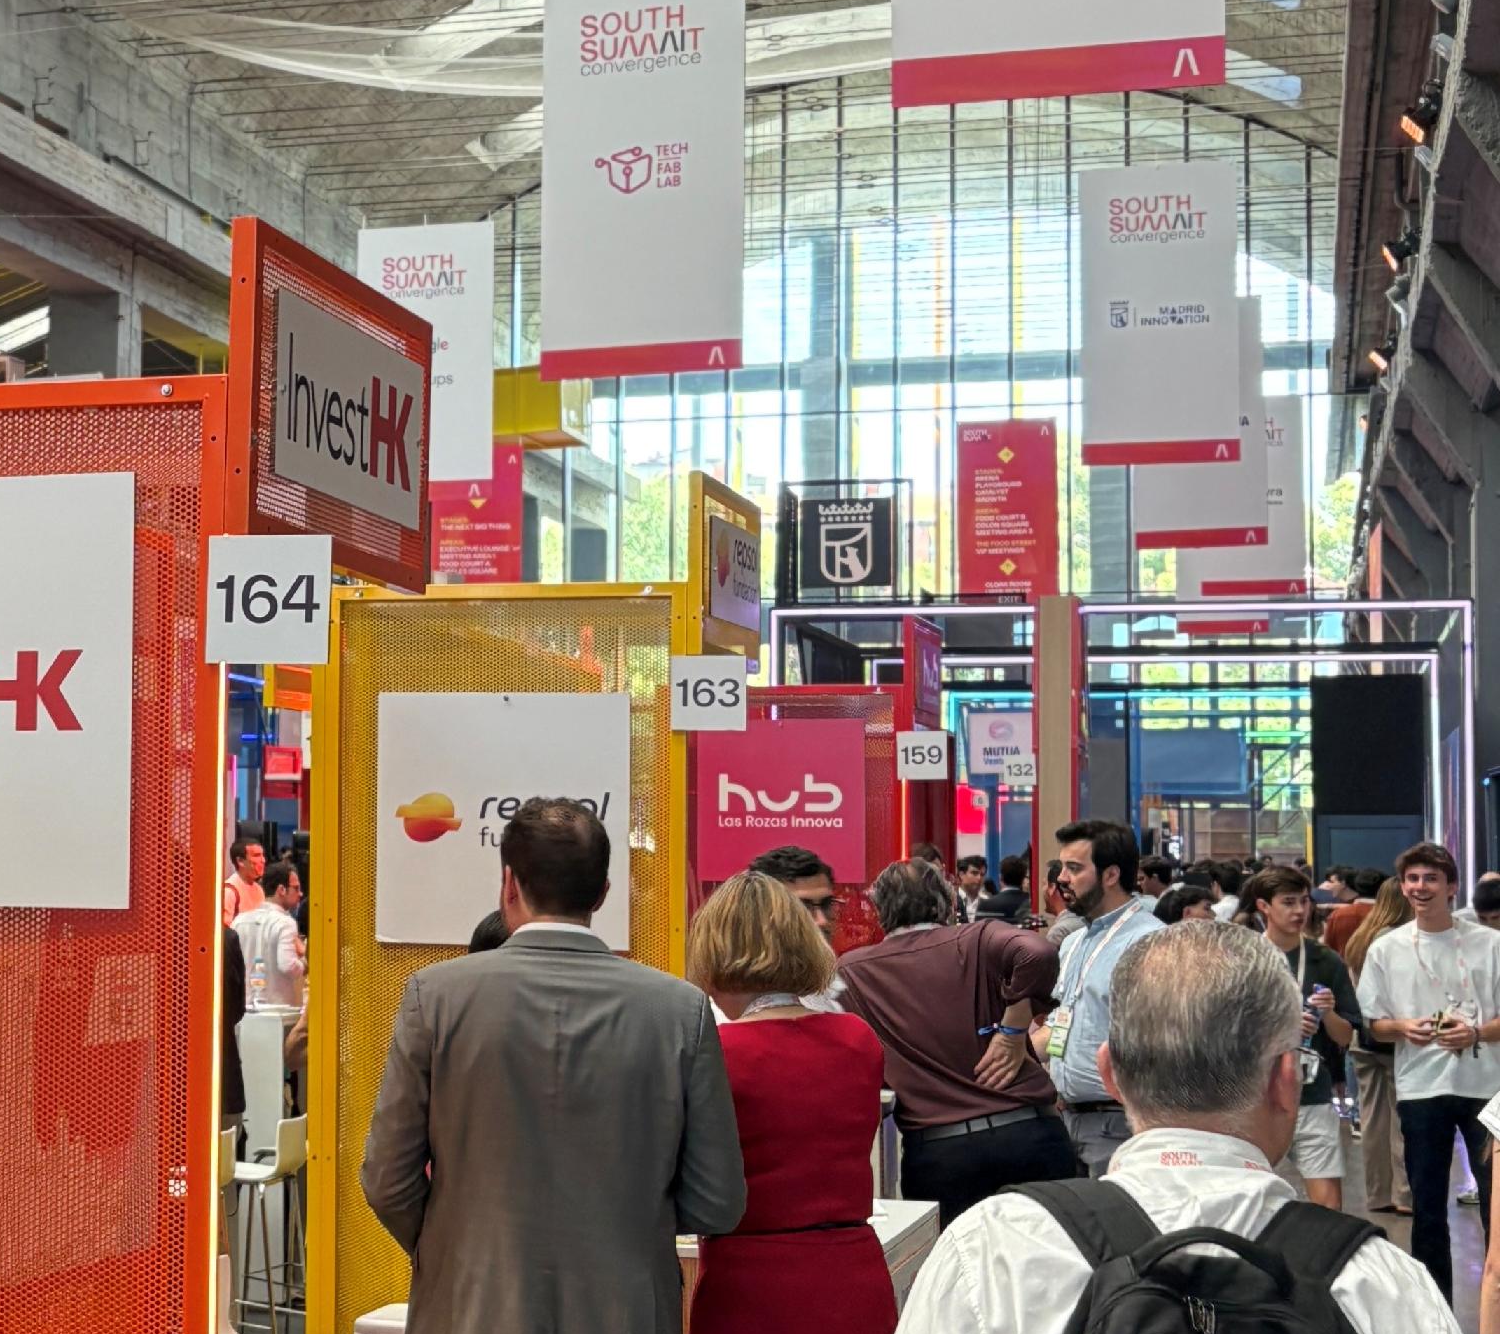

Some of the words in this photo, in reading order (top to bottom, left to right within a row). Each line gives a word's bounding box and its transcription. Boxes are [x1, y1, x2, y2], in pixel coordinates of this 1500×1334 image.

[580, 4, 684, 37] SOUTH
[580, 27, 705, 63] SUMMIT
[580, 52, 702, 77] convergence
[655, 142, 688, 156] TECH
[657, 161, 681, 174] FAB
[657, 175, 681, 188] LAB
[1109, 194, 1191, 215] SOUTH
[1109, 211, 1207, 233] SUMMIT
[1109, 229, 1205, 244] convergence
[382, 253, 453, 273] SOUTH
[382, 270, 467, 290] SUMMIT
[1159, 304, 1205, 315] MADRID
[1141, 314, 1210, 326] INNOVATION
[288, 332, 414, 492] InvestHK
[216, 574, 320, 624] 164
[675, 678, 740, 708] 163
[900, 746, 943, 765] 159
[983, 747, 1020, 756] MUTUA
[1006, 763, 1034, 777] 132
[718, 773, 843, 812] hub
[479, 791, 611, 821] rel
[718, 815, 742, 828] Las
[745, 815, 788, 828] Rozas
[791, 815, 843, 828] Innova
[1160, 1151, 1198, 1160] SOUTH
